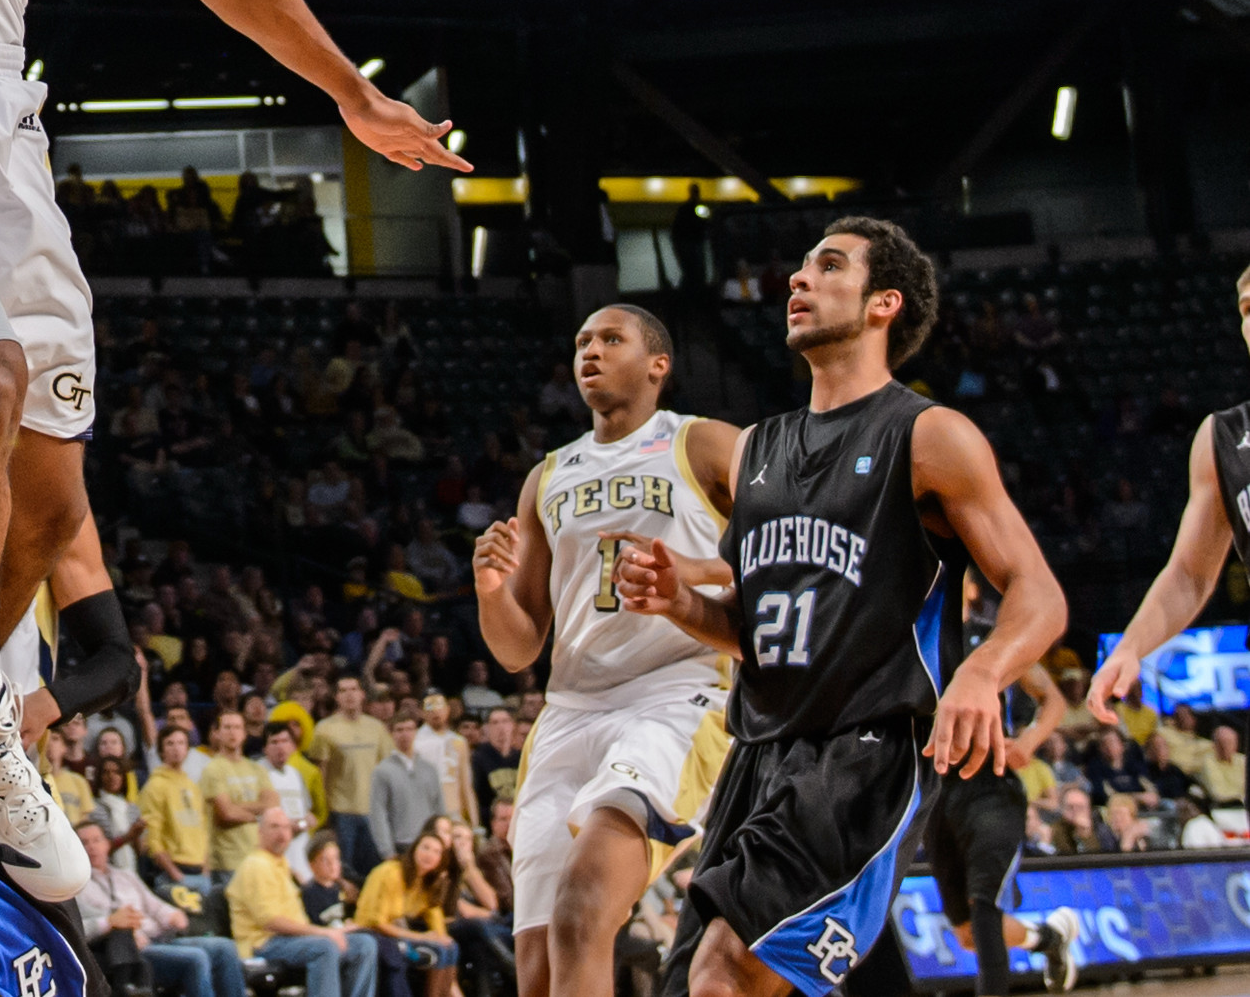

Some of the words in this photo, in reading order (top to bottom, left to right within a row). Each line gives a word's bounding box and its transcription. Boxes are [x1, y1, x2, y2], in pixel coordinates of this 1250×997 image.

[52, 372, 91, 411] GT
[546, 475, 674, 535] TECH
[754, 588, 816, 667] 21
